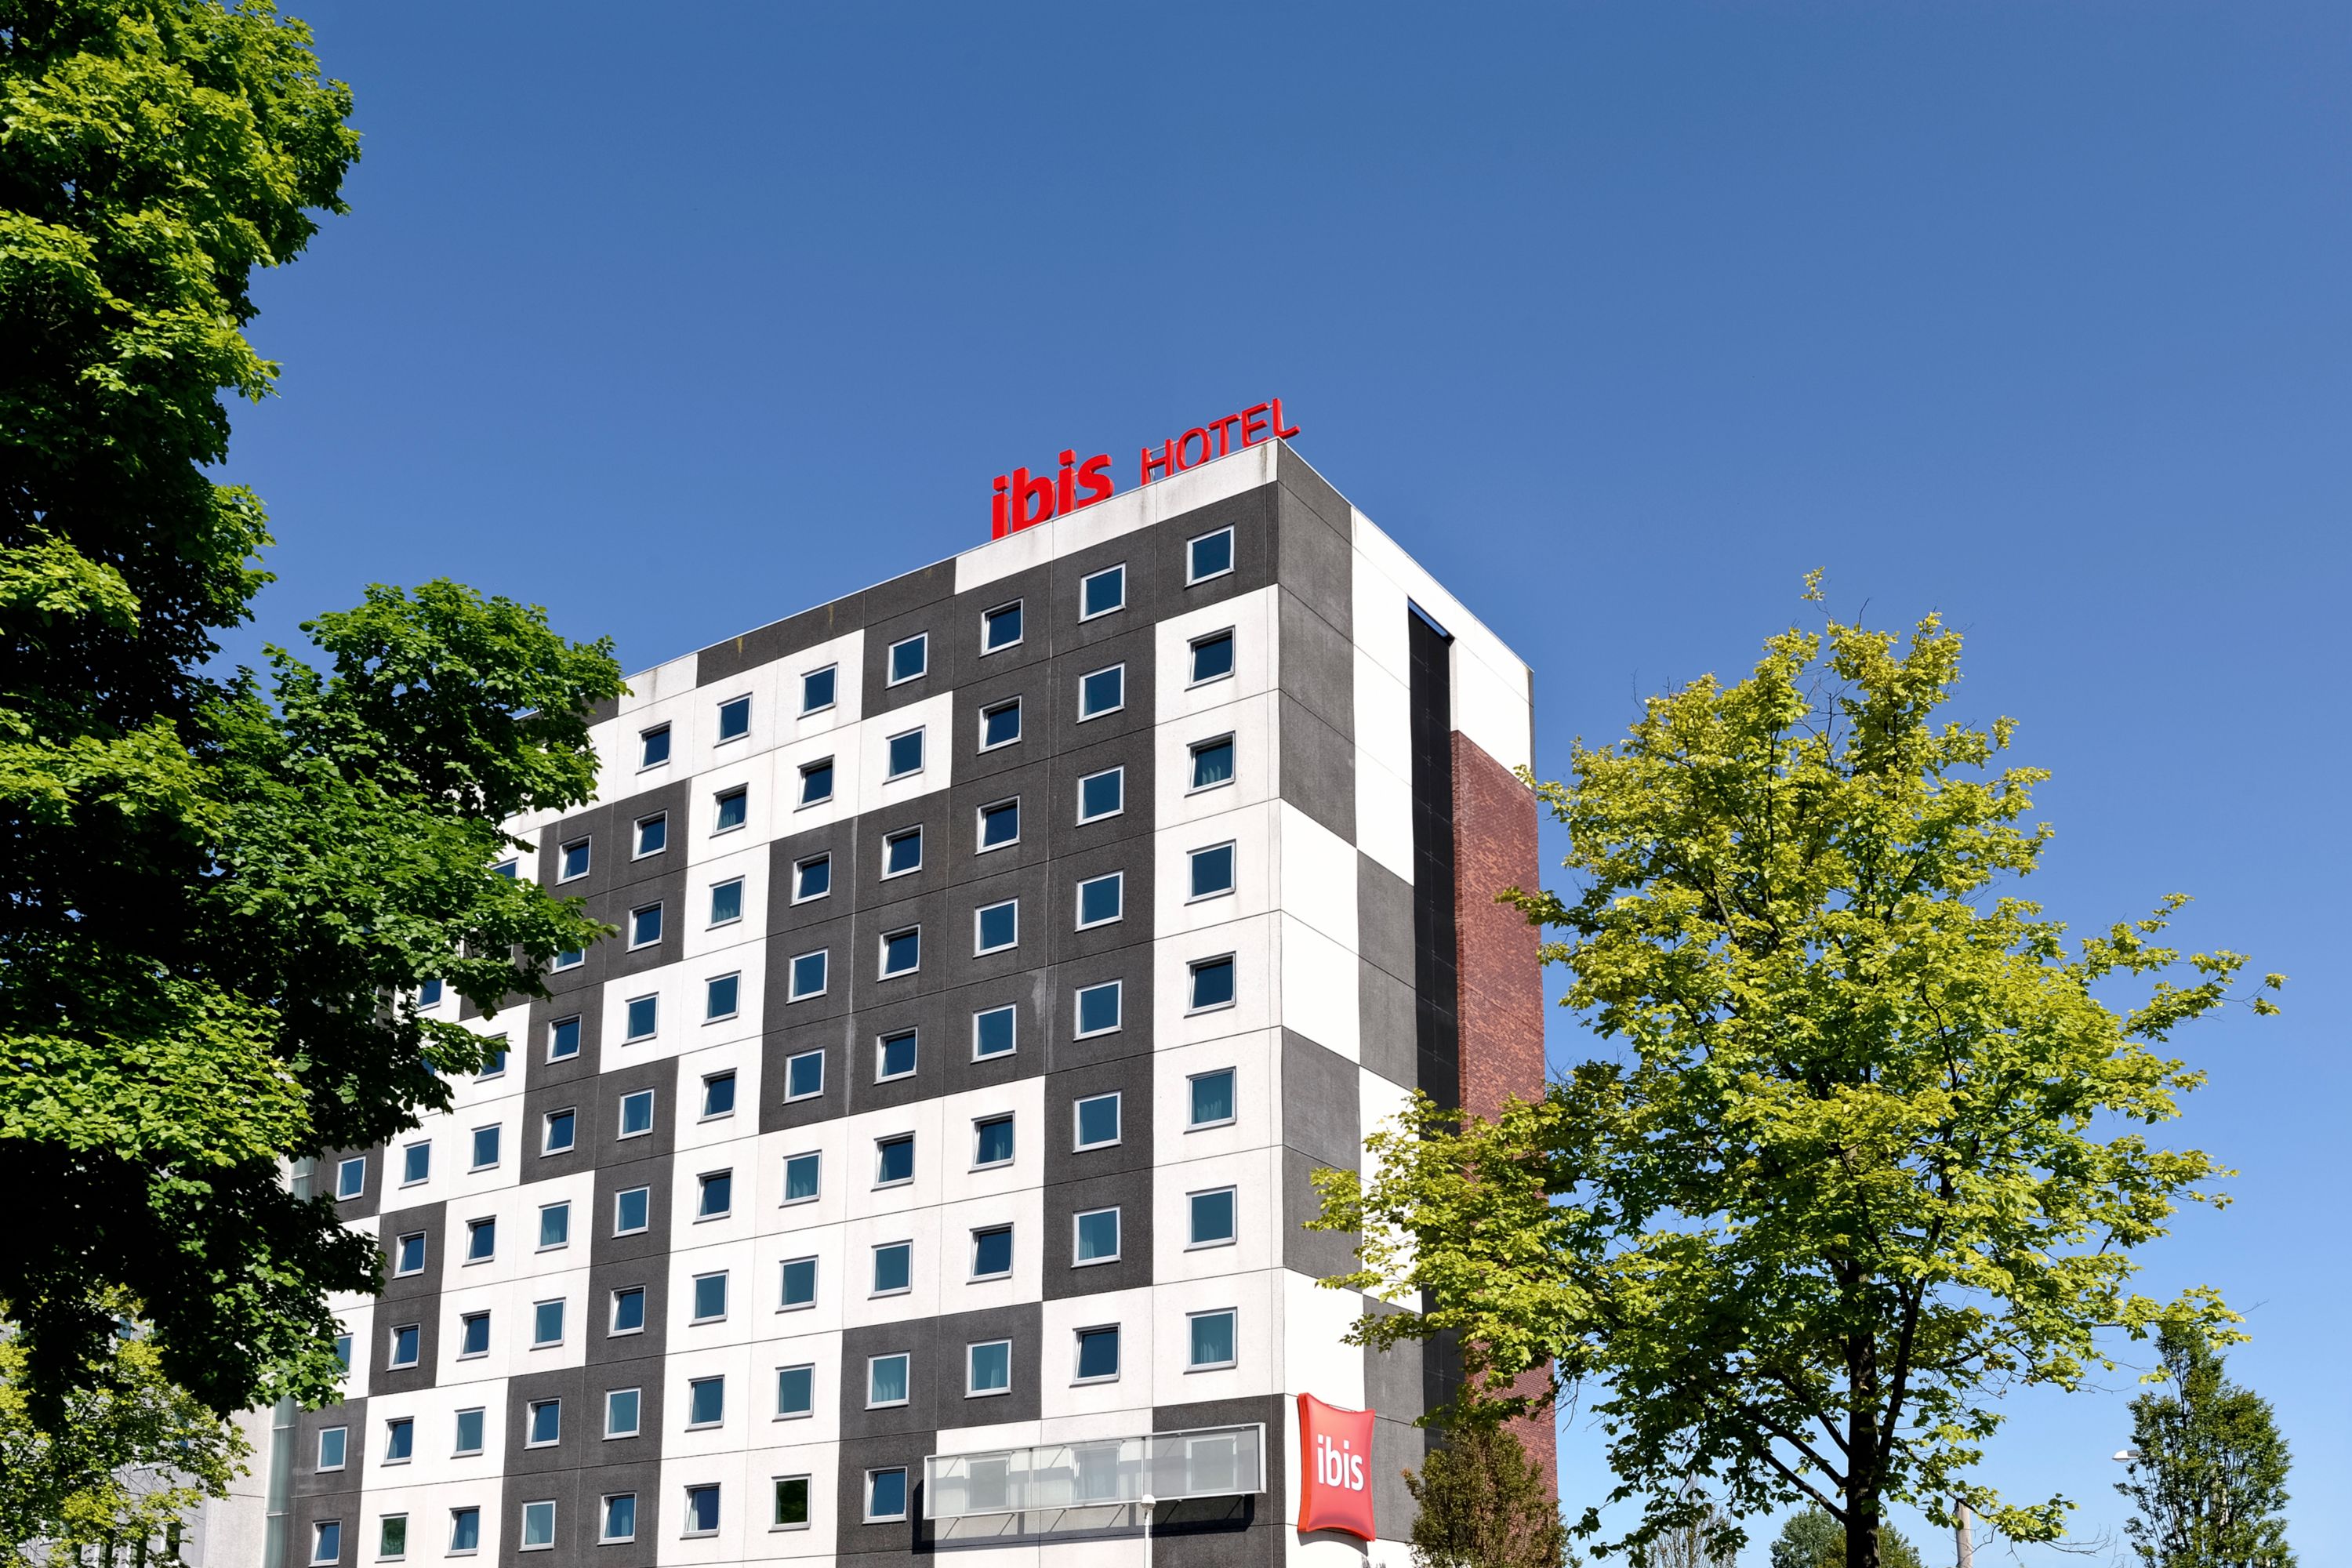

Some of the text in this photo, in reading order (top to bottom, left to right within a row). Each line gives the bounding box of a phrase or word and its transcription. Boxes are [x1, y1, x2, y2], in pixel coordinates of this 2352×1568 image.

[991, 397, 1301, 541] ibis HOTEL
[1317, 1434, 1365, 1491] ibis
